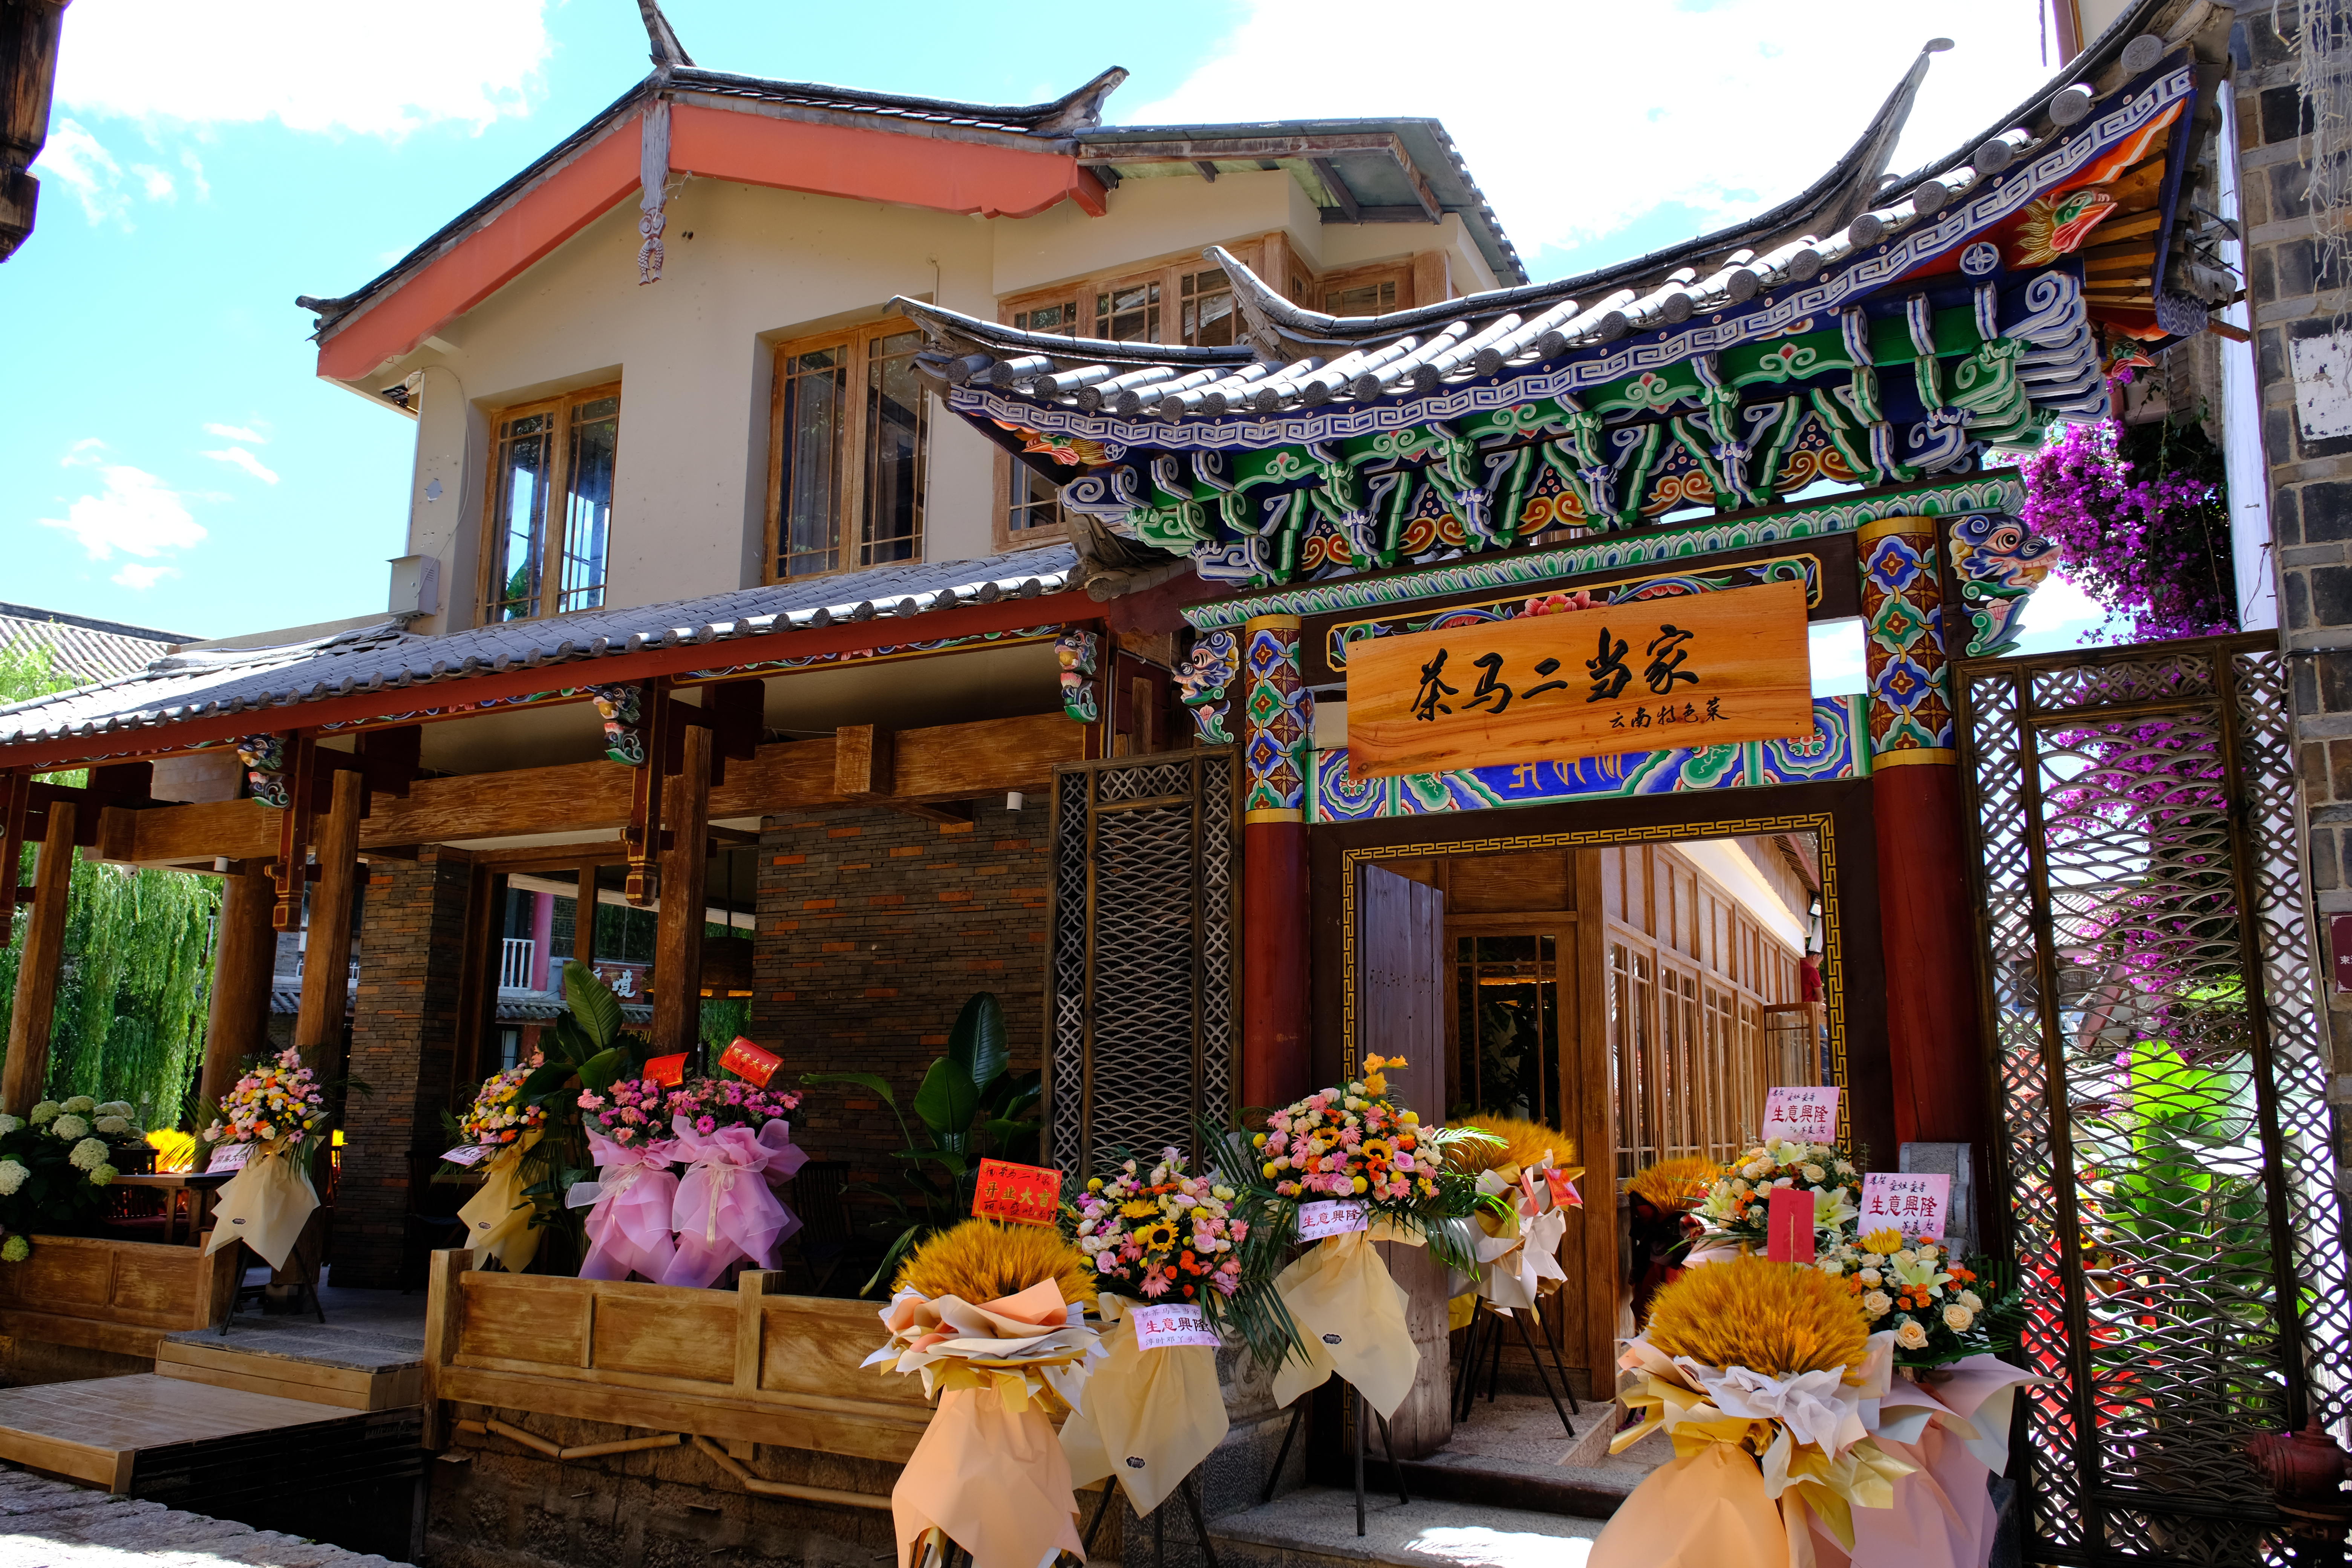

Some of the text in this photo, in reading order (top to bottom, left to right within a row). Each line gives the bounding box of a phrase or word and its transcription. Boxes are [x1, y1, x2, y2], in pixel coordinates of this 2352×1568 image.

[1410, 624, 1699, 721] 茶马二当家
[1610, 696, 1730, 730] 云南特色菜
[2339, 956, 2352, 965] 束
[1771, 1105, 1828, 1123] 生意興隆
[984, 1181, 1052, 1207] 开业大吉
[1868, 1195, 1938, 1217] 生意興隆
[1302, 1208, 1360, 1229] 生意興隆
[1141, 1308, 1200, 1318] 祝茶马二当家
[1145, 1317, 1208, 1335] 生意興隆
